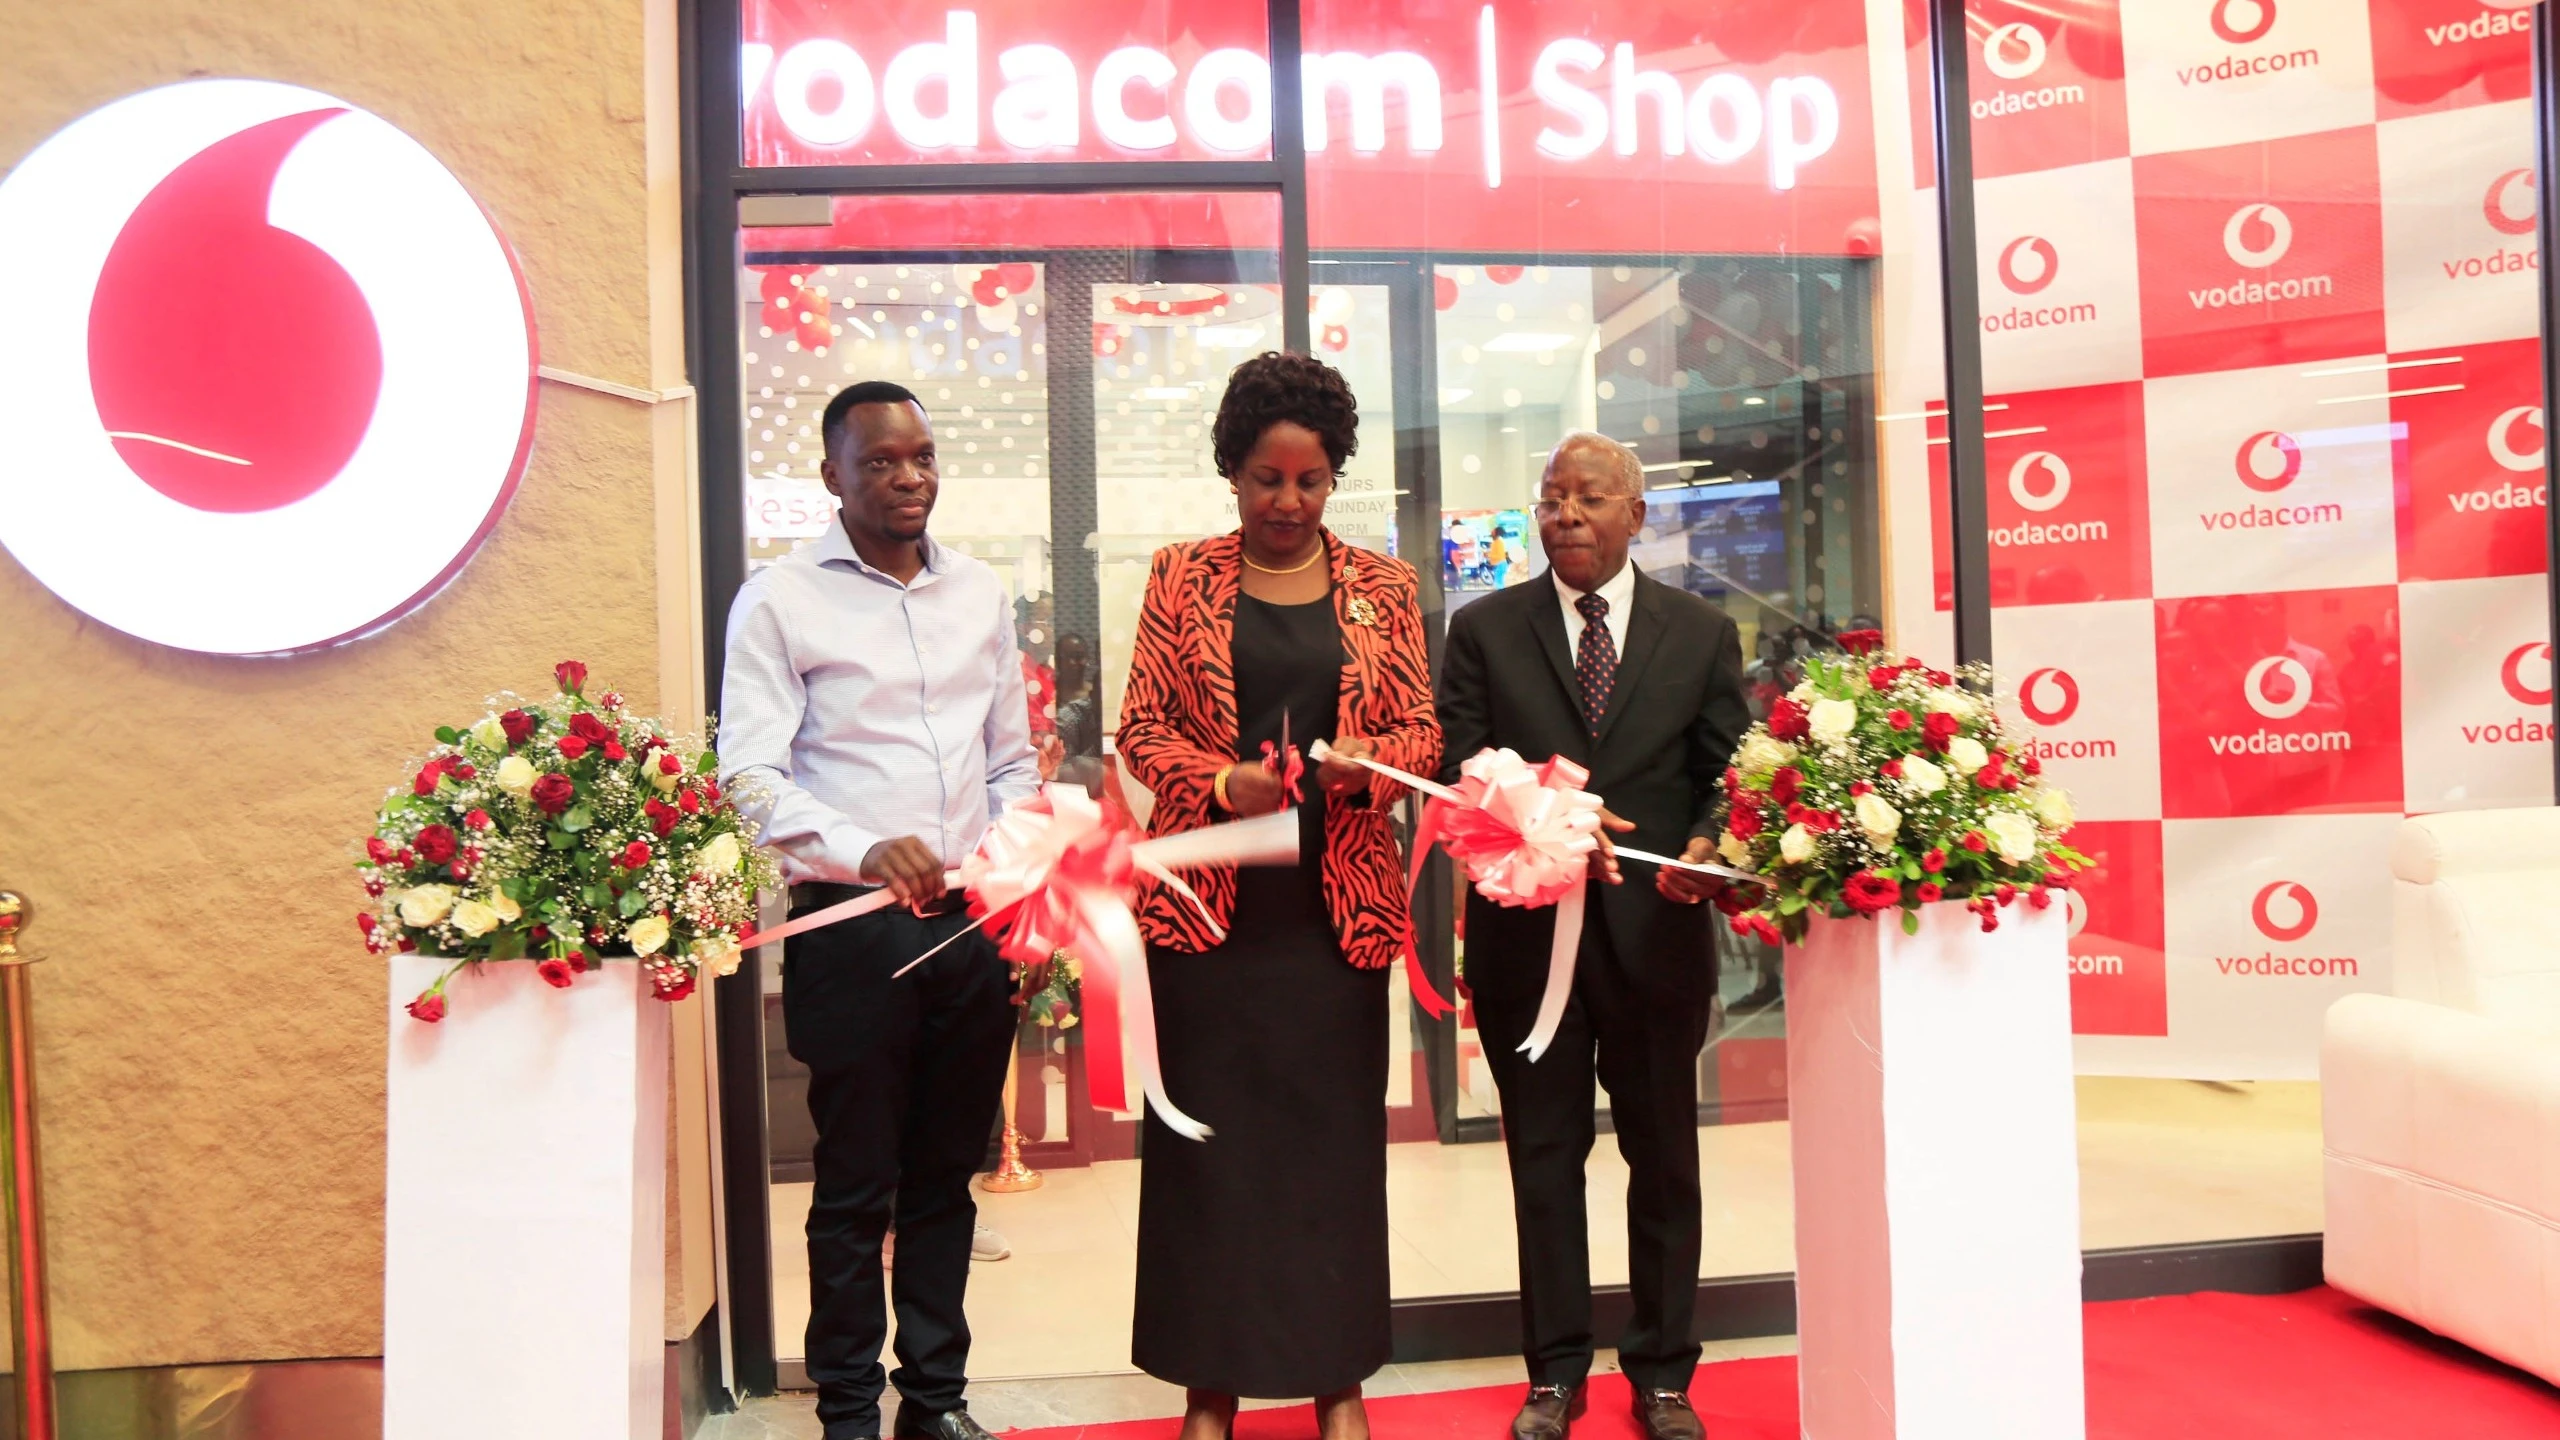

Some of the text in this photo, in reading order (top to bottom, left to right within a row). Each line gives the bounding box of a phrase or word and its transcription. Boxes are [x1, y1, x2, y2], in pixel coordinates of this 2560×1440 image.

[2176, 48, 2319, 88] vodacom
[1535, 38, 1840, 190] Shop
[2188, 275, 2333, 310] vodacom
[1979, 303, 2097, 333] odacom
[1324, 500, 1387, 514] SUNDAY
[2200, 503, 2343, 532] vodacom
[2207, 727, 2352, 756] vodacom
[2215, 951, 2358, 977] vodacom
